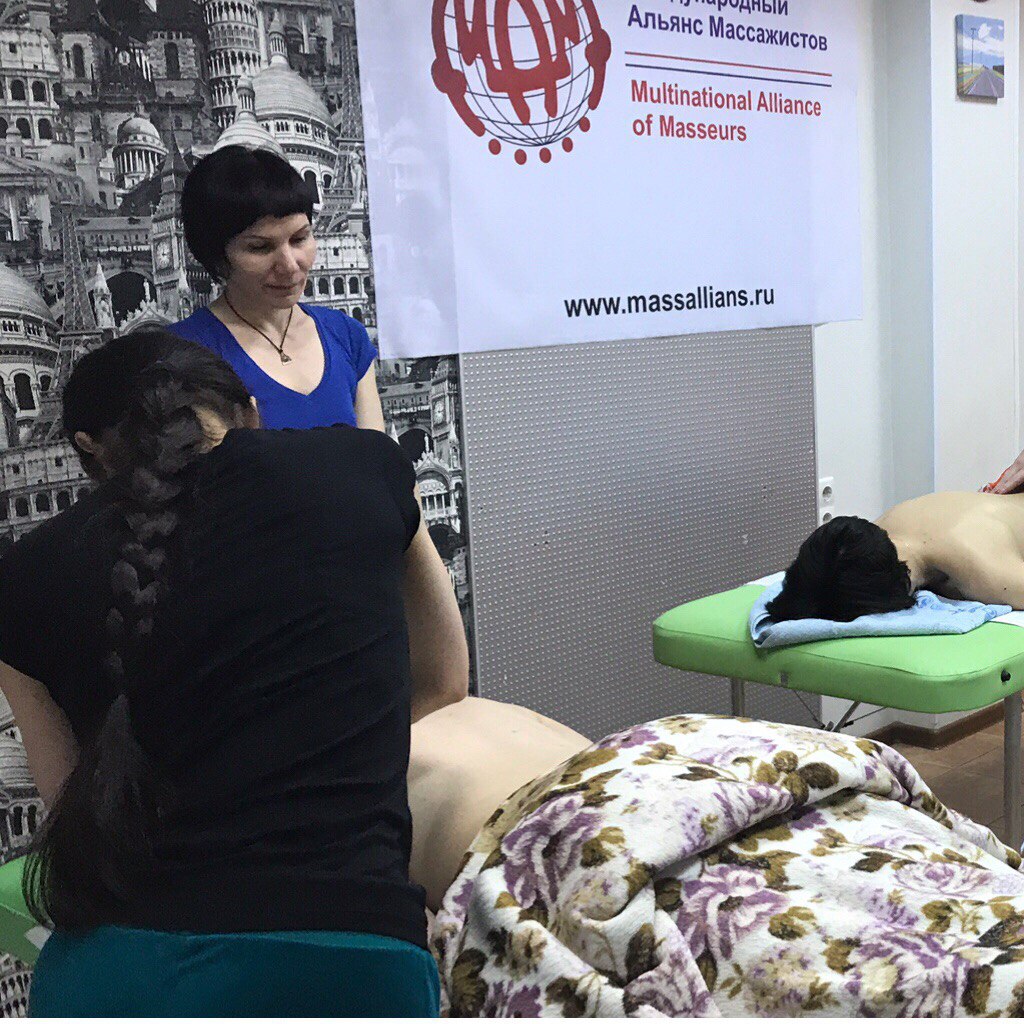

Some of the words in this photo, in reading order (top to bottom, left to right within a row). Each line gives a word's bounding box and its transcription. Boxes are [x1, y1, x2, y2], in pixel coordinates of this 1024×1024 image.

[627, 4, 704, 36] Альянс
[709, 15, 828, 51] Массажистов
[631, 79, 752, 111] Multinational
[756, 90, 822, 117] Alliance
[632, 113, 653, 137] of
[659, 114, 747, 142] Masseurs
[563, 286, 775, 318] www.massallians.ru
